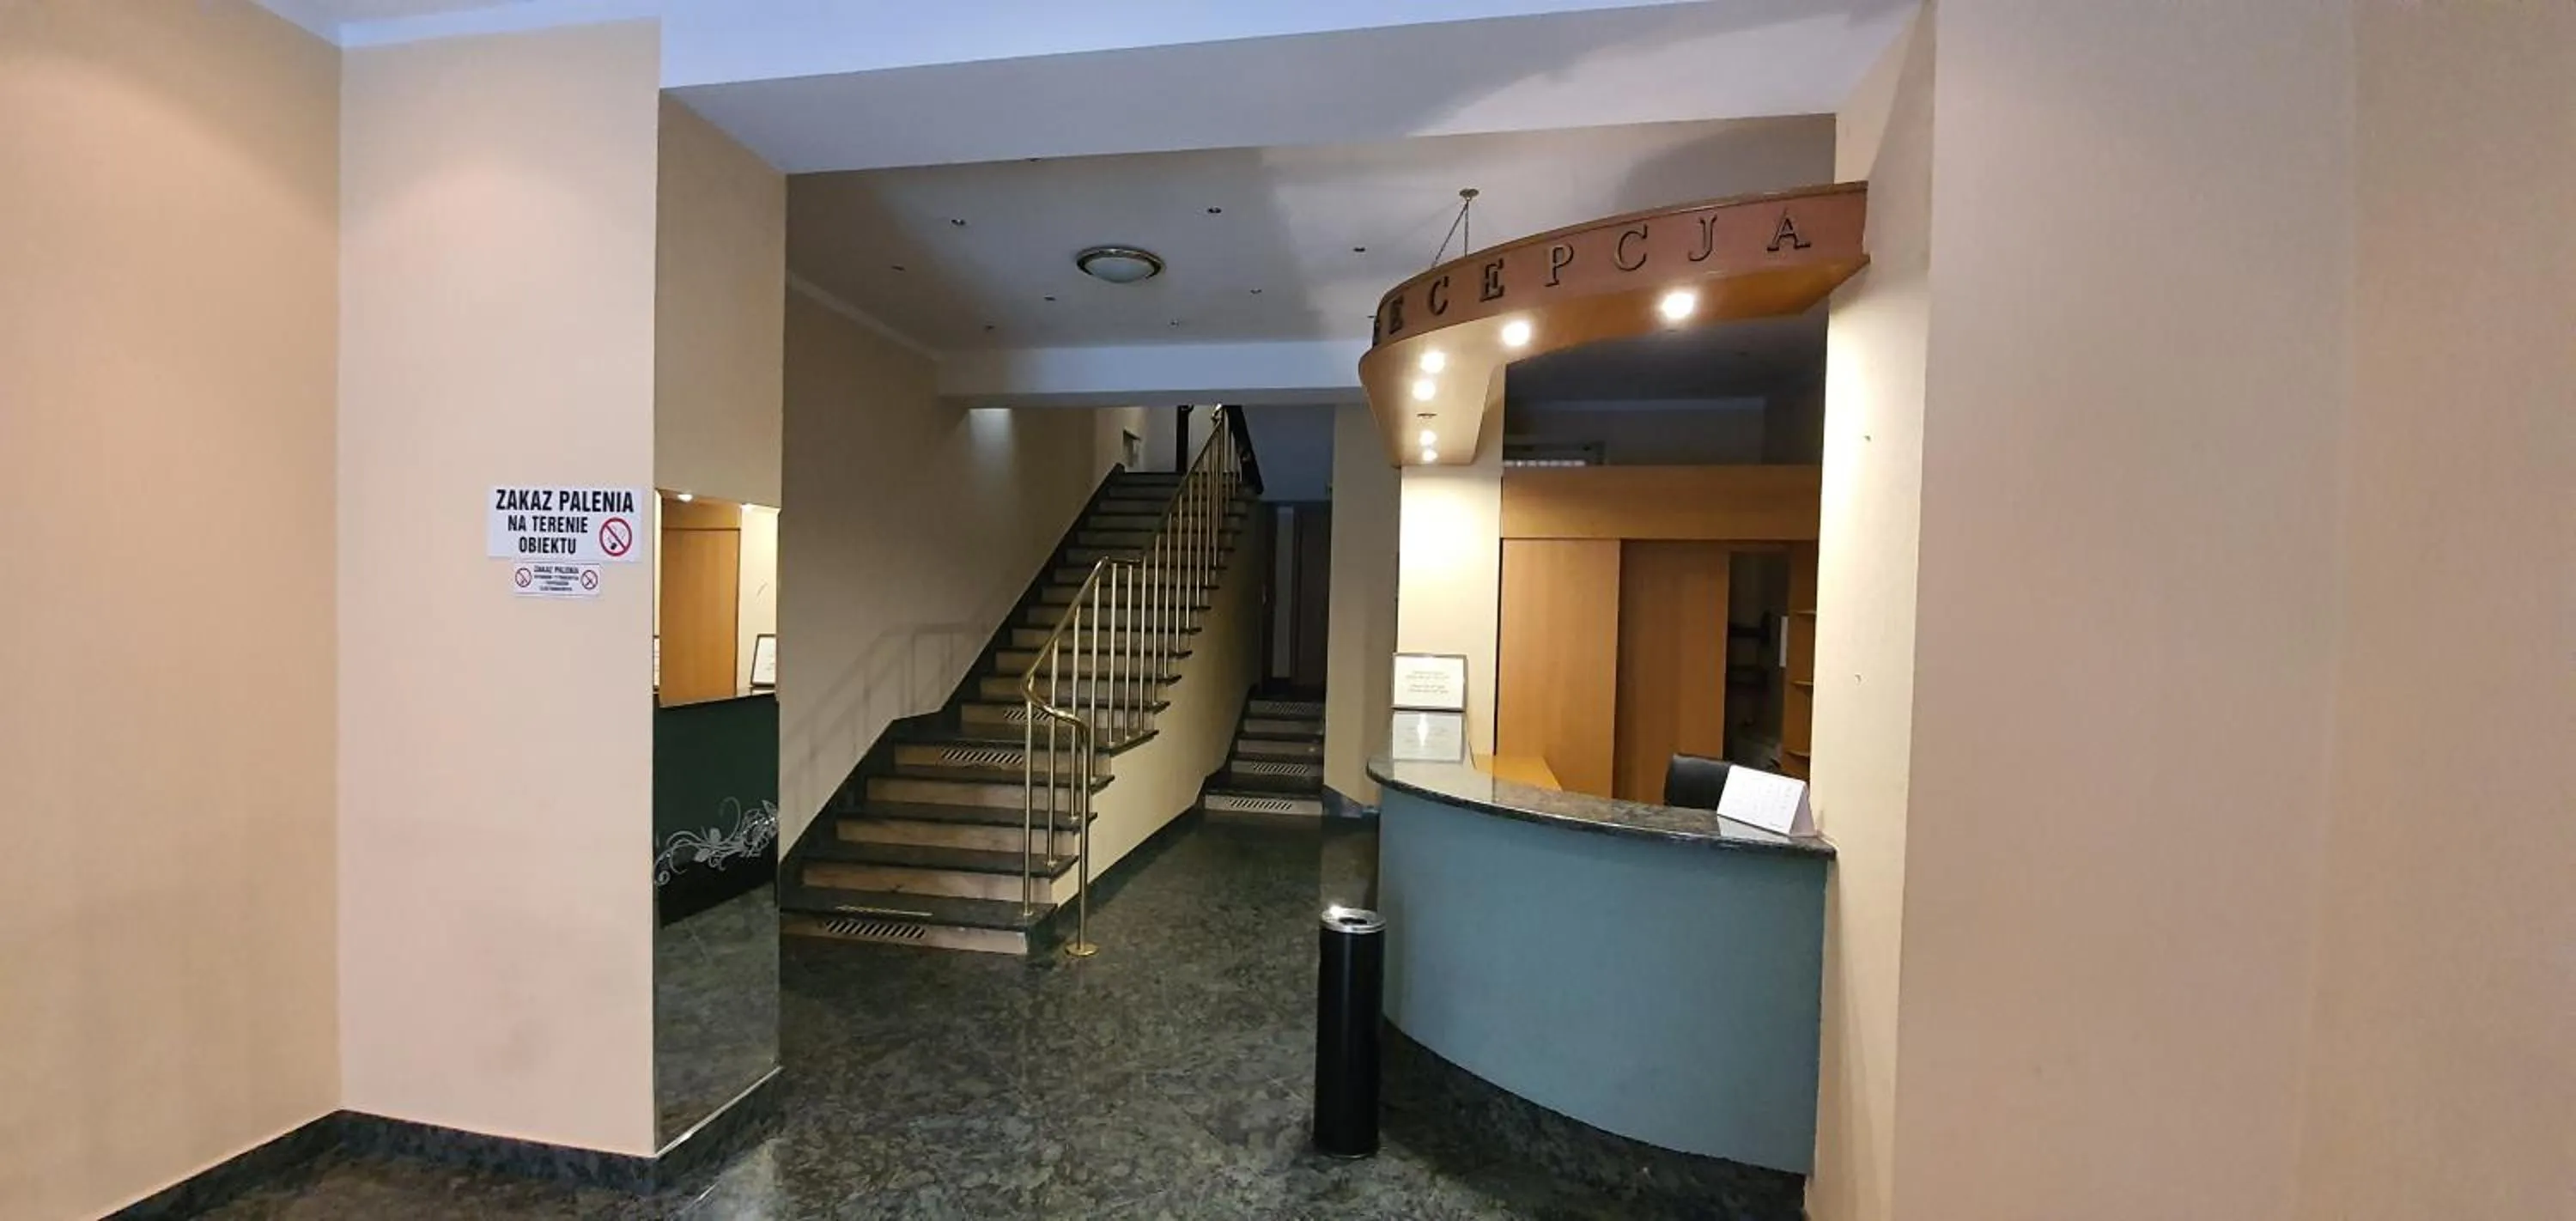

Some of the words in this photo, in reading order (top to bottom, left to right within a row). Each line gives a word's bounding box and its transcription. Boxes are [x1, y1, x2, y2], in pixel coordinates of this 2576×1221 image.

[495, 489, 553, 511] ZAKAZ
[559, 490, 635, 513] PALENIA
[507, 515, 526, 532] NA
[532, 516, 588, 533] TERENIE
[519, 537, 577, 554] OBIEKTU
